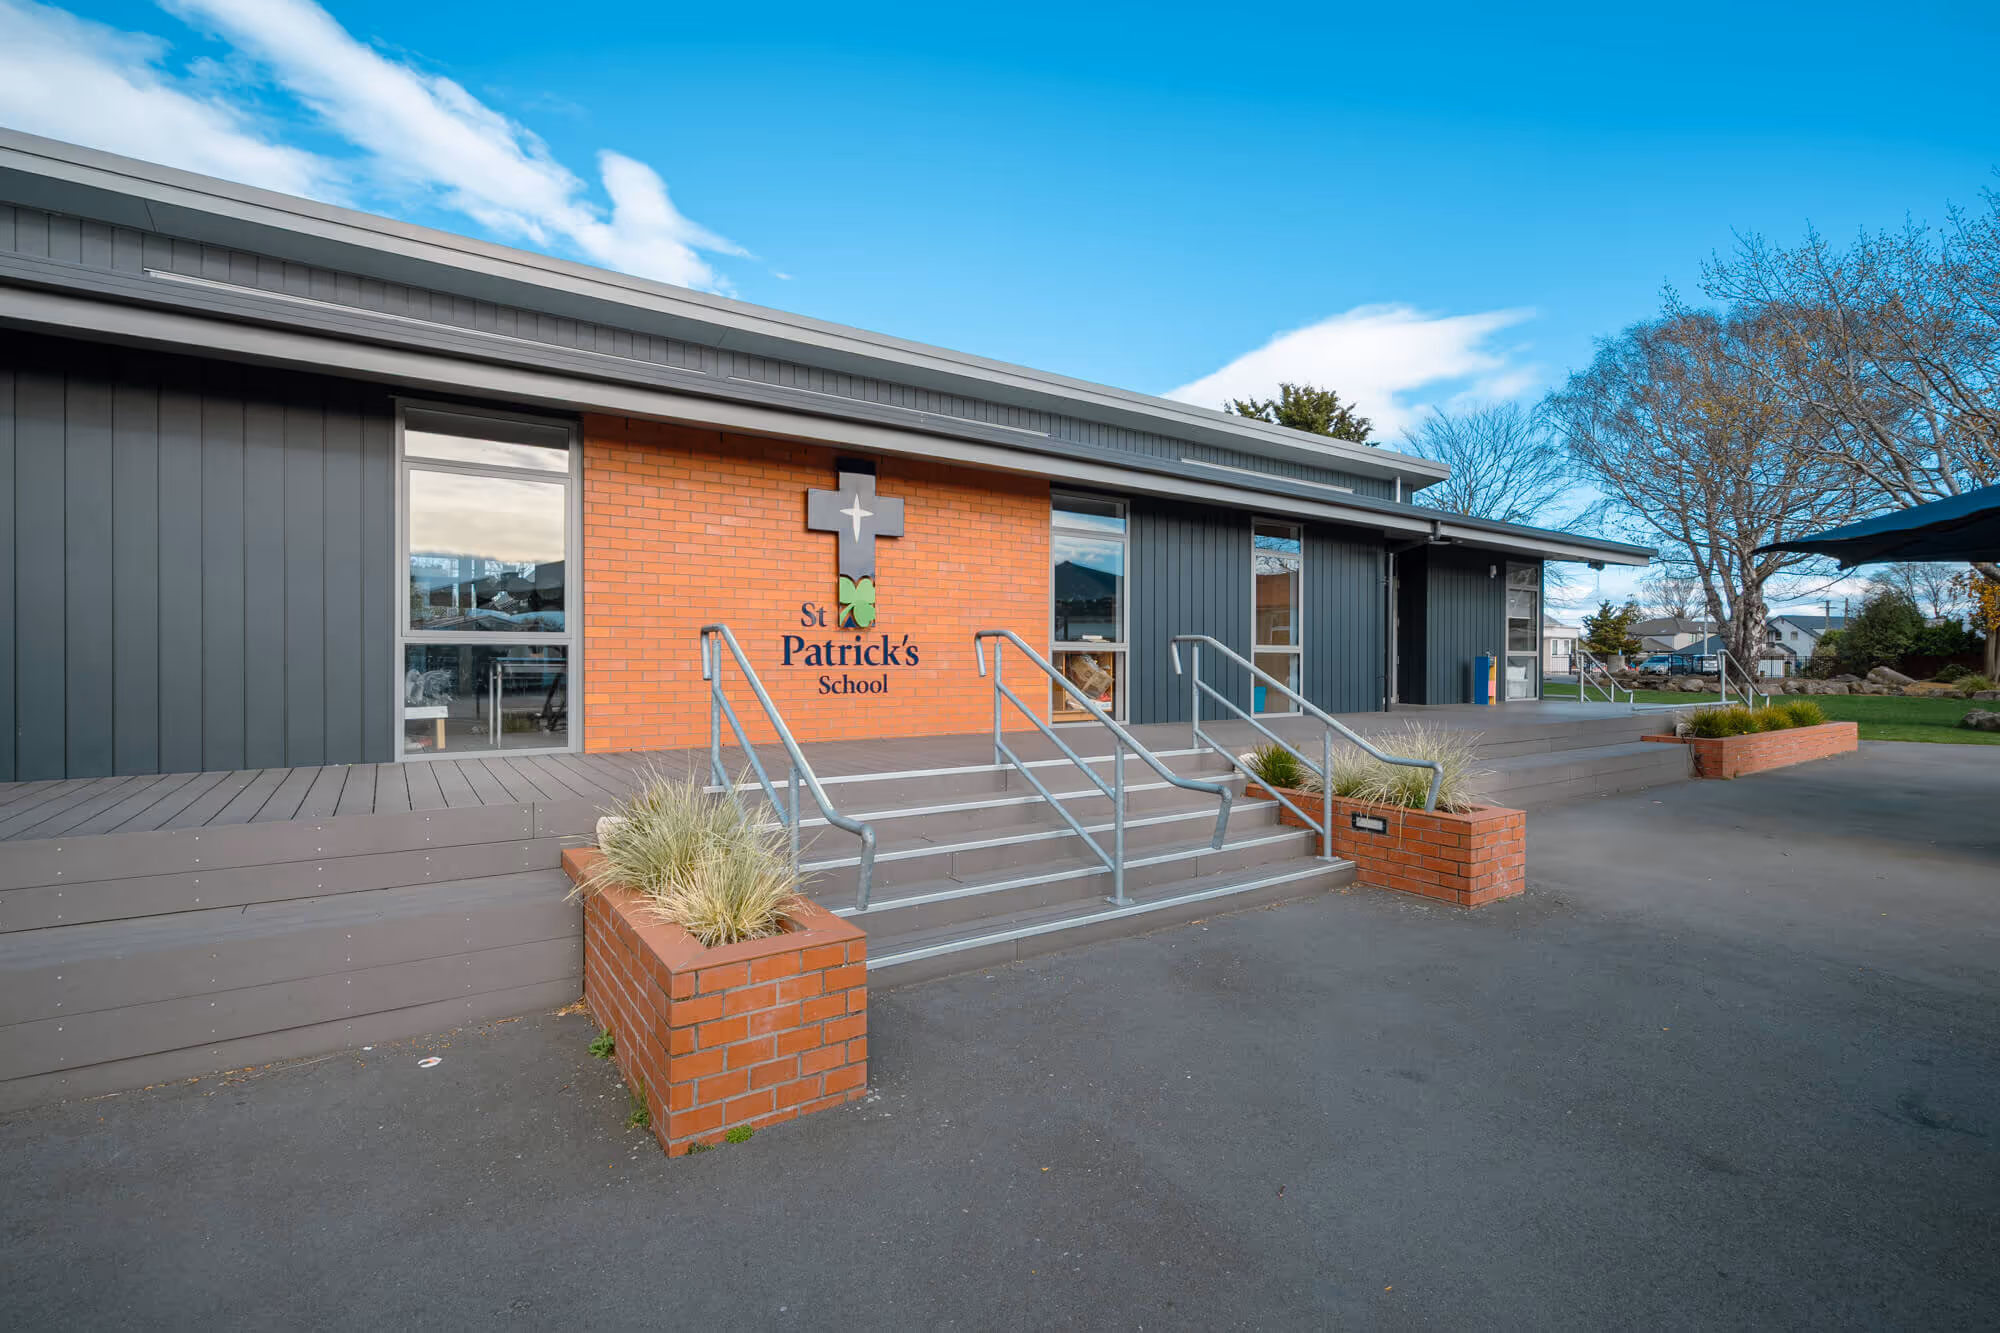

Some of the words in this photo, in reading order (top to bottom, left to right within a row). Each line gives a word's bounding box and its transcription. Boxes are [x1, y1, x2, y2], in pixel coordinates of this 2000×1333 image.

[801, 602, 827, 627] St
[781, 634, 919, 666] Patrick's
[818, 674, 888, 694] School
